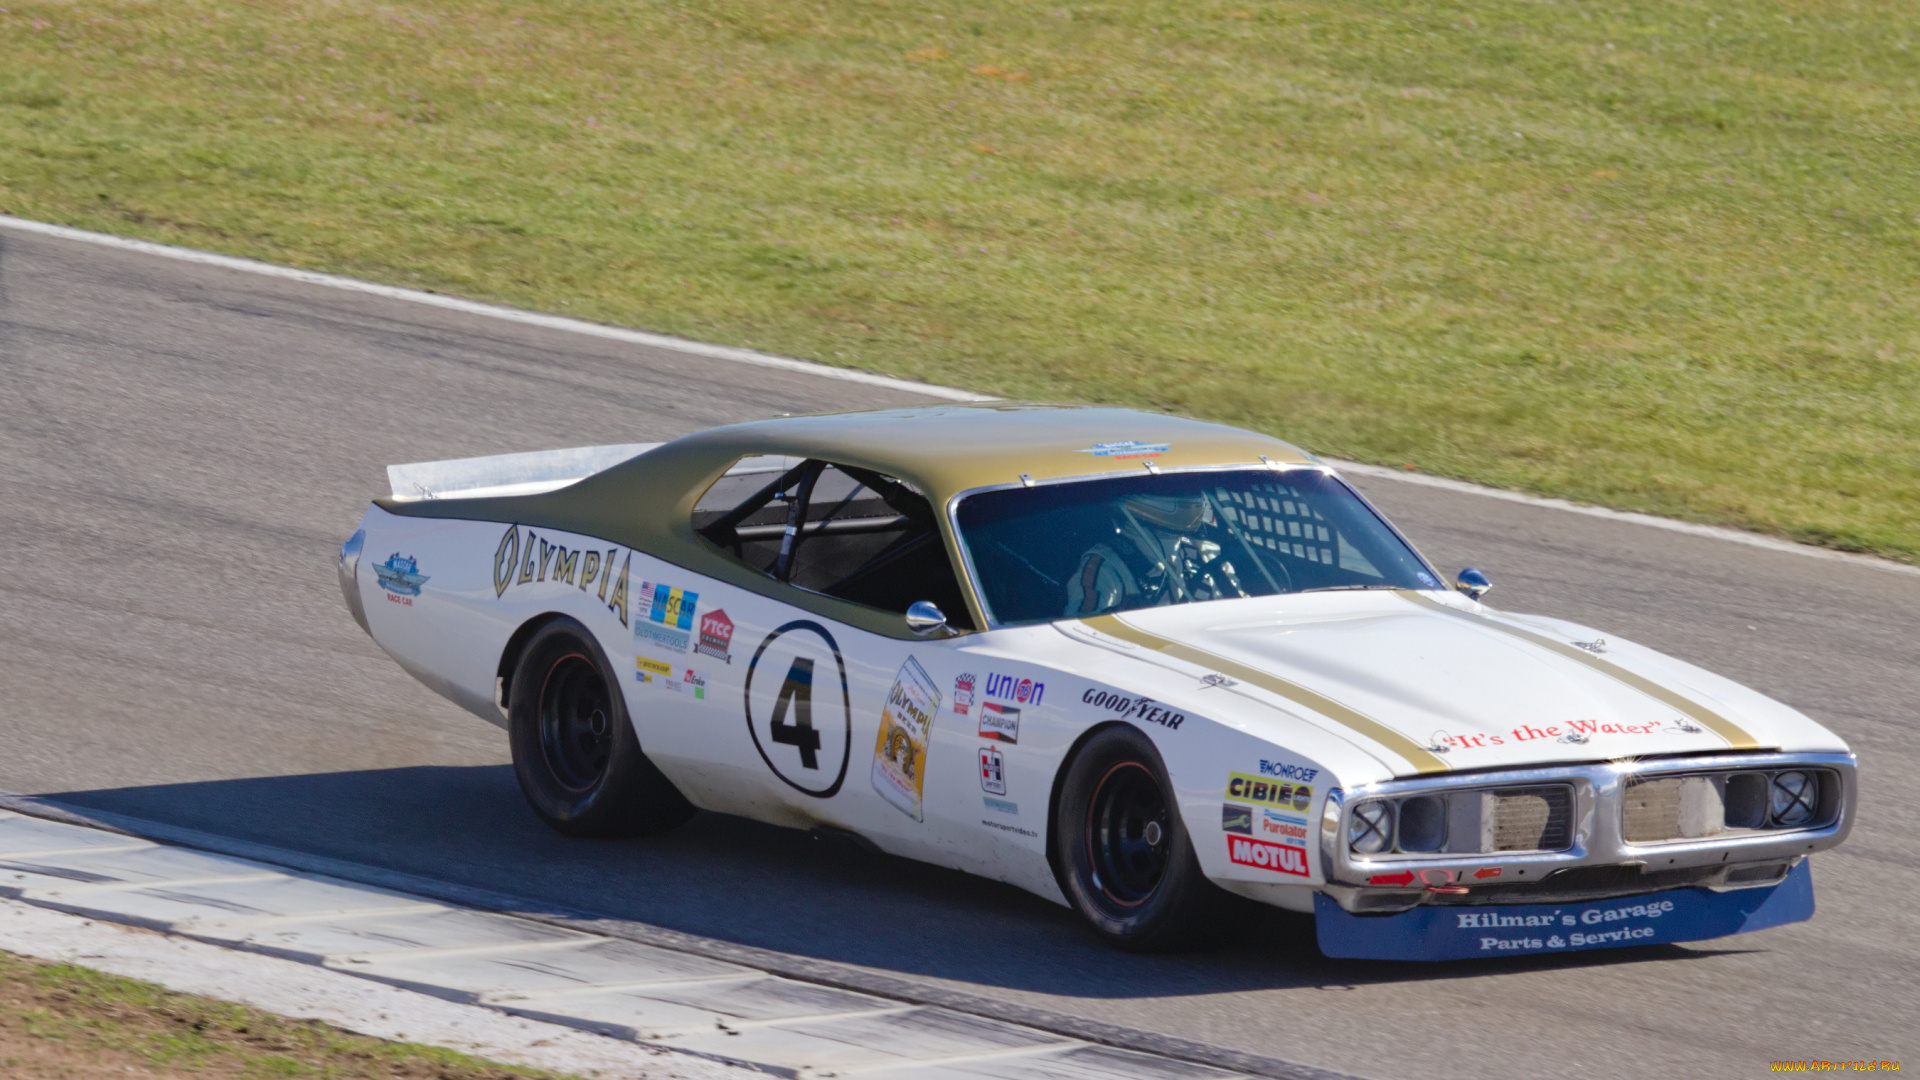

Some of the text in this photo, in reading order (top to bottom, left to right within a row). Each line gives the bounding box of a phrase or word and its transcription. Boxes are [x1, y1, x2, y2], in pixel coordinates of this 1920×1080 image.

[493, 521, 632, 630] OLYMPIA
[387, 593, 414, 606] RACE CAR
[653, 589, 697, 618] NASCAR
[702, 617, 731, 638] YTCC
[643, 660, 670, 672] DUNLOP
[770, 662, 822, 771] 4
[982, 714, 1017, 731] CHAMPION
[1511, 725, 1562, 742] the
[1264, 762, 1313, 782] MONROE
[982, 820, 1038, 839] motorsportvideo.tv
[1263, 818, 1308, 839] Purolator
[1233, 838, 1306, 873] MOTUL
[1581, 900, 1674, 925] Garage
[1480, 926, 1655, 950] Parts & Service
